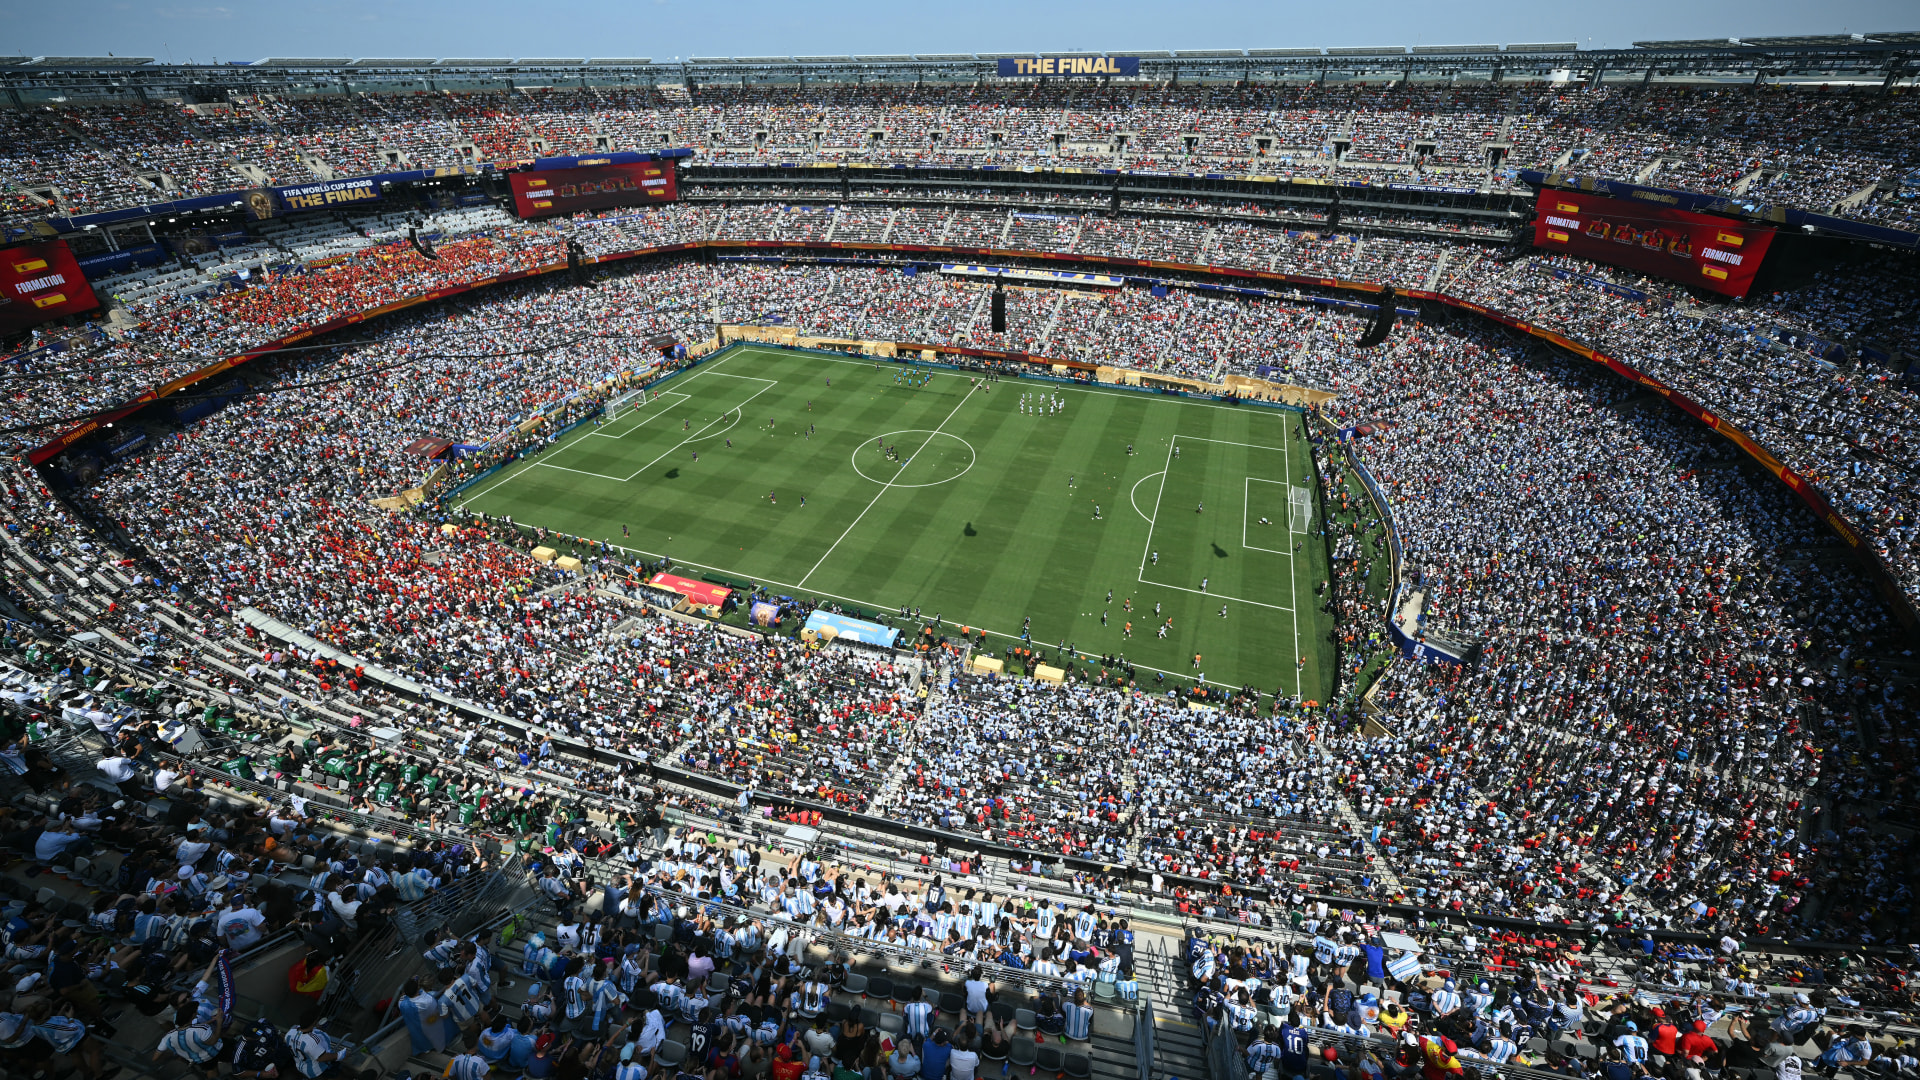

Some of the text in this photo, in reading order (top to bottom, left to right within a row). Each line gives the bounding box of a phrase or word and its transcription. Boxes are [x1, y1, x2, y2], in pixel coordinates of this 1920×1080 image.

[1014, 57, 1120, 74] THE FINAL
[283, 180, 373, 197] FIFA WORLD CUP 2026
[286, 187, 377, 209] THE FINAL
[1632, 190, 1679, 205] #FIFAWorldCup
[1545, 215, 1580, 230] FORMATION
[1701, 247, 1743, 266] FORMATION
[1027, 269, 1054, 277] FINAL
[15, 273, 65, 294] FORMATION
[283, 330, 313, 345] FORMATION
[63, 421, 98, 445] FORMATION
[1827, 513, 1859, 547] FORMATION
[838, 620, 878, 633] ARGENTINA
[930, 890, 940, 904] 10
[1040, 915, 1048, 927] 10
[1080, 920, 1090, 931] 10
[1319, 946, 1331, 955] 10
[220, 968, 230, 988] WORLD
[1124, 990, 1136, 1000] 10
[1278, 995, 1289, 1004] 10
[691, 1033, 706, 1052] 19
[1287, 1035, 1304, 1055] 10
[255, 1047, 268, 1057] 10
[1634, 1046, 1645, 1059] 10
